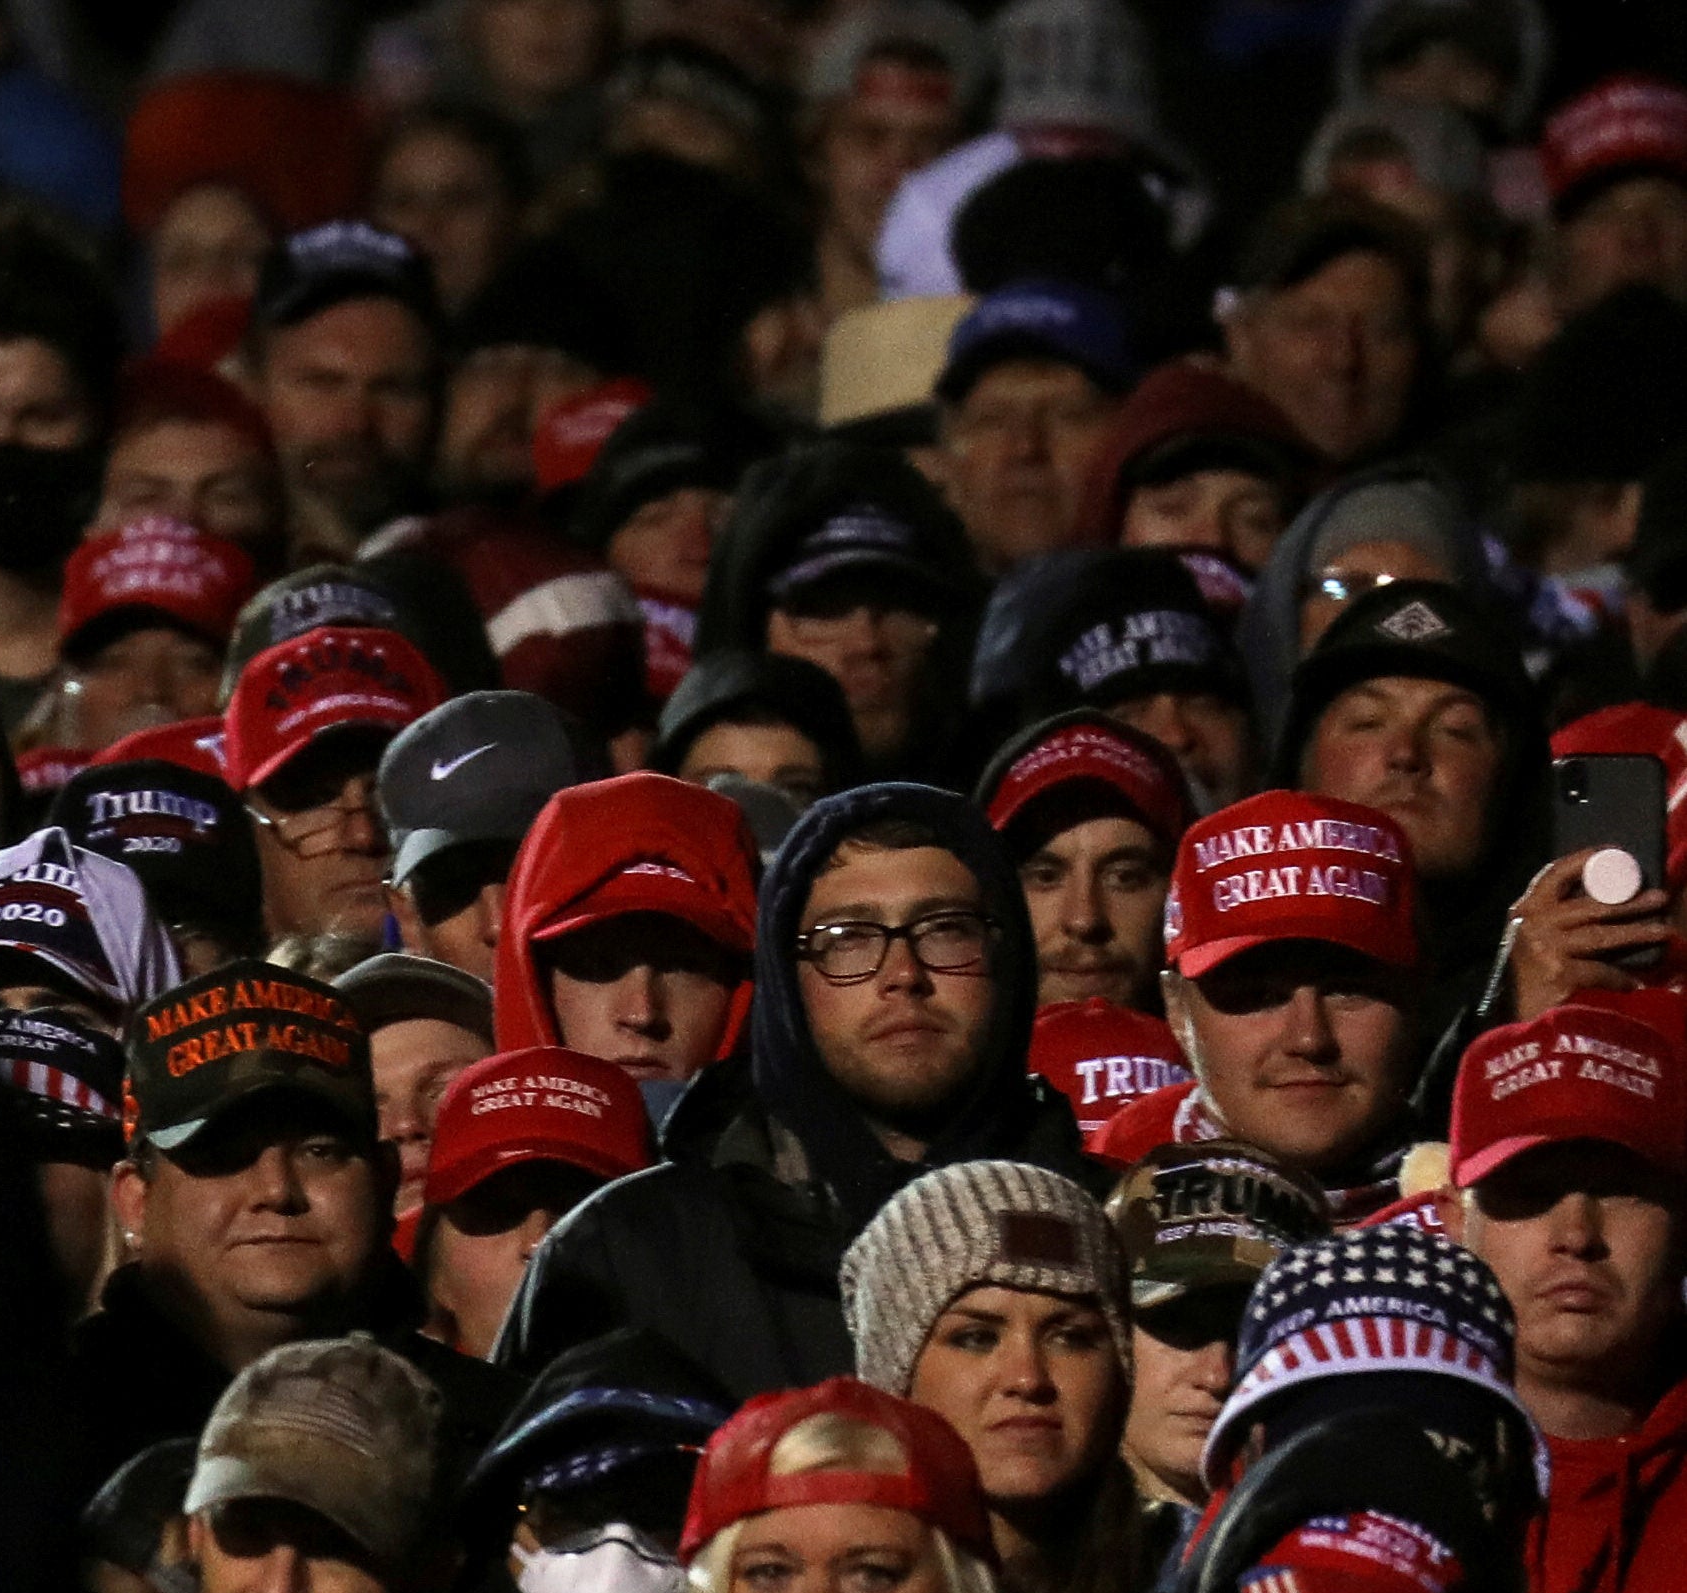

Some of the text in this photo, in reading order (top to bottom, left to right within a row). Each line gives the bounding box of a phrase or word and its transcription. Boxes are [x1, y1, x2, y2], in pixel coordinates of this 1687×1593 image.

[86, 790, 217, 829] Trump
[123, 836, 182, 853] 2020
[1189, 819, 1398, 875] MAKE AMERICA
[1209, 864, 1395, 913] GREAT AGAIN
[143, 977, 359, 1043] MAKE AMERICA
[6, 1017, 98, 1056] AMERICA
[166, 1021, 350, 1079] GREAT AGAIN
[1483, 1034, 1658, 1081] MAKE AMERICA
[468, 1074, 611, 1107] MAKE AMERICA
[1488, 1058, 1653, 1102] GREAT AGAIN
[468, 1091, 602, 1119] GREAT AGAIN
[1325, 1295, 1444, 1327] AMERICA
